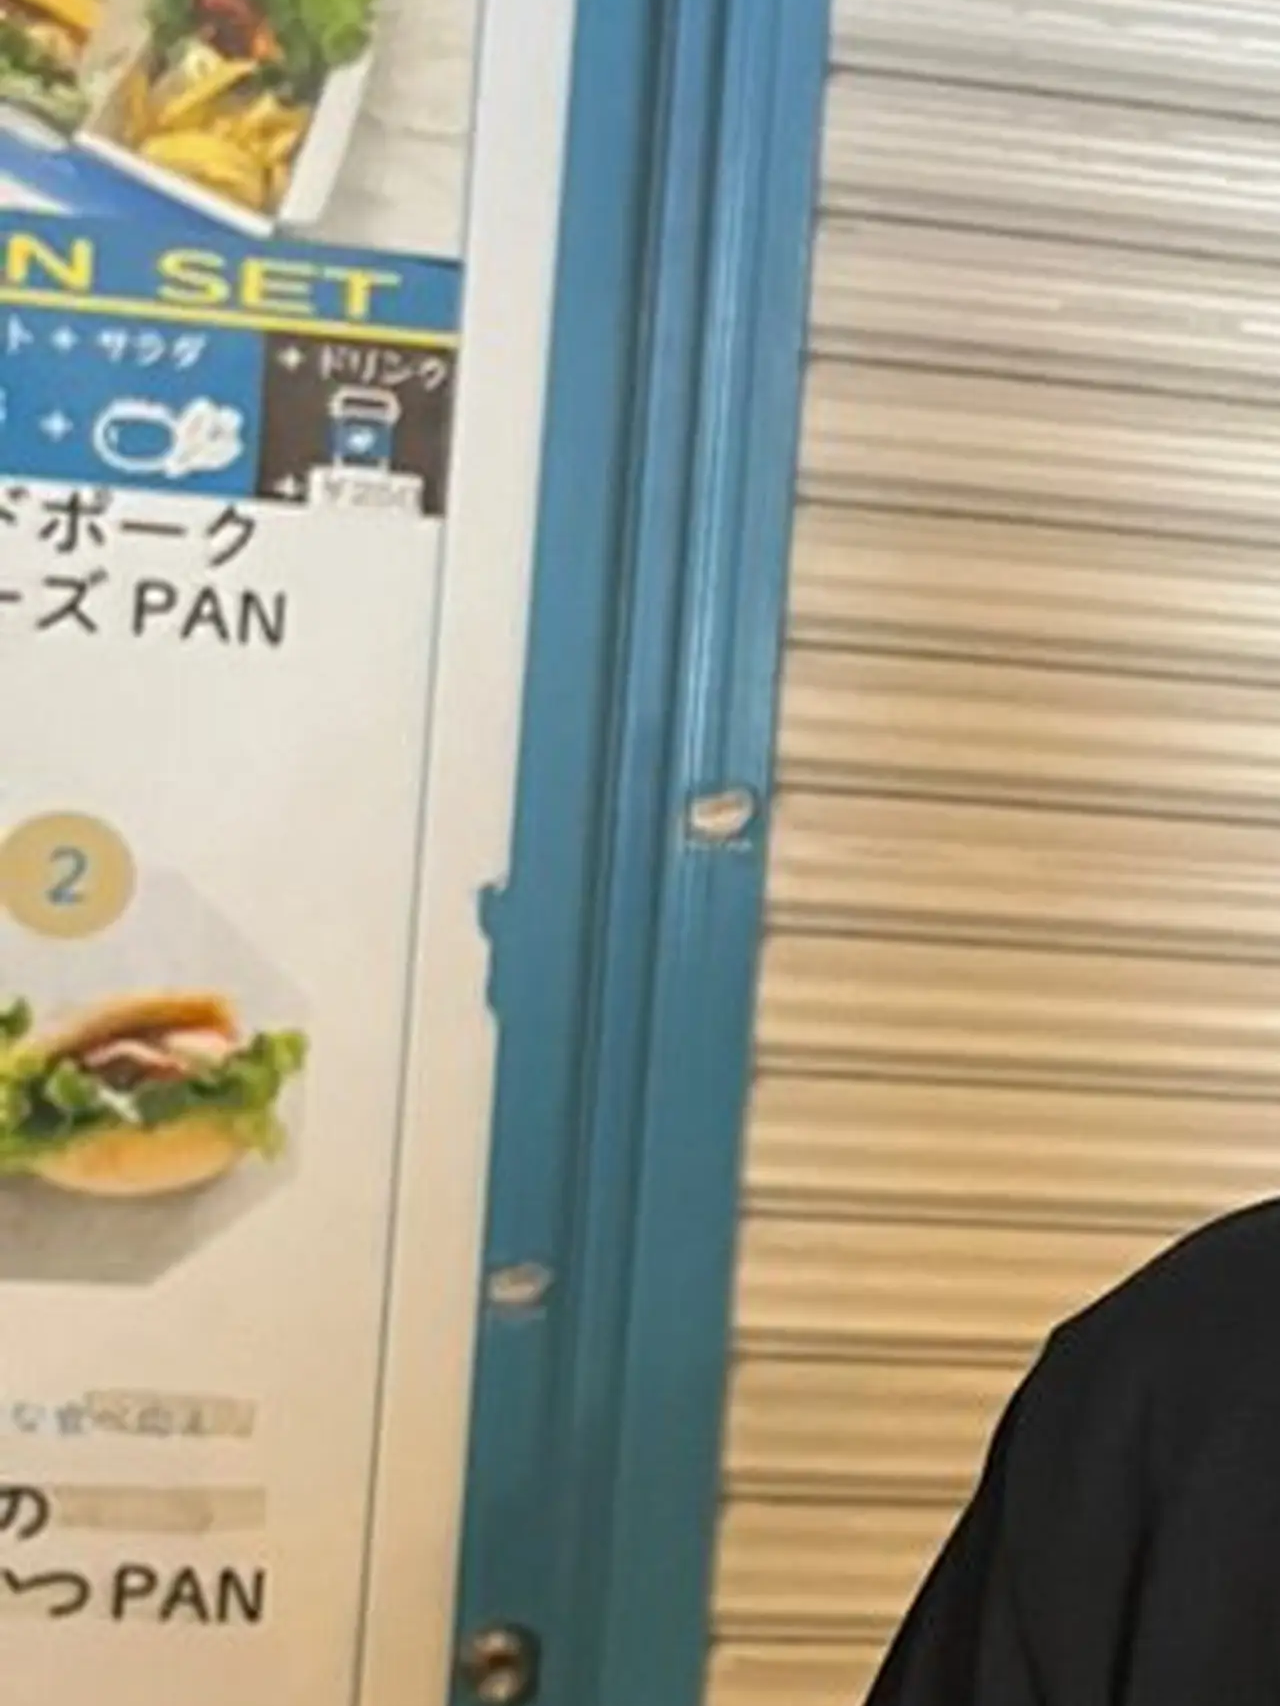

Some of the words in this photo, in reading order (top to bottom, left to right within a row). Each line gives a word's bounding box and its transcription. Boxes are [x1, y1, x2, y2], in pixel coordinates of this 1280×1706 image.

[157, 247, 403, 321] SET
[132, 578, 287, 648] PAN
[46, 845, 89, 906] 2
[110, 1562, 267, 1625] PAN
